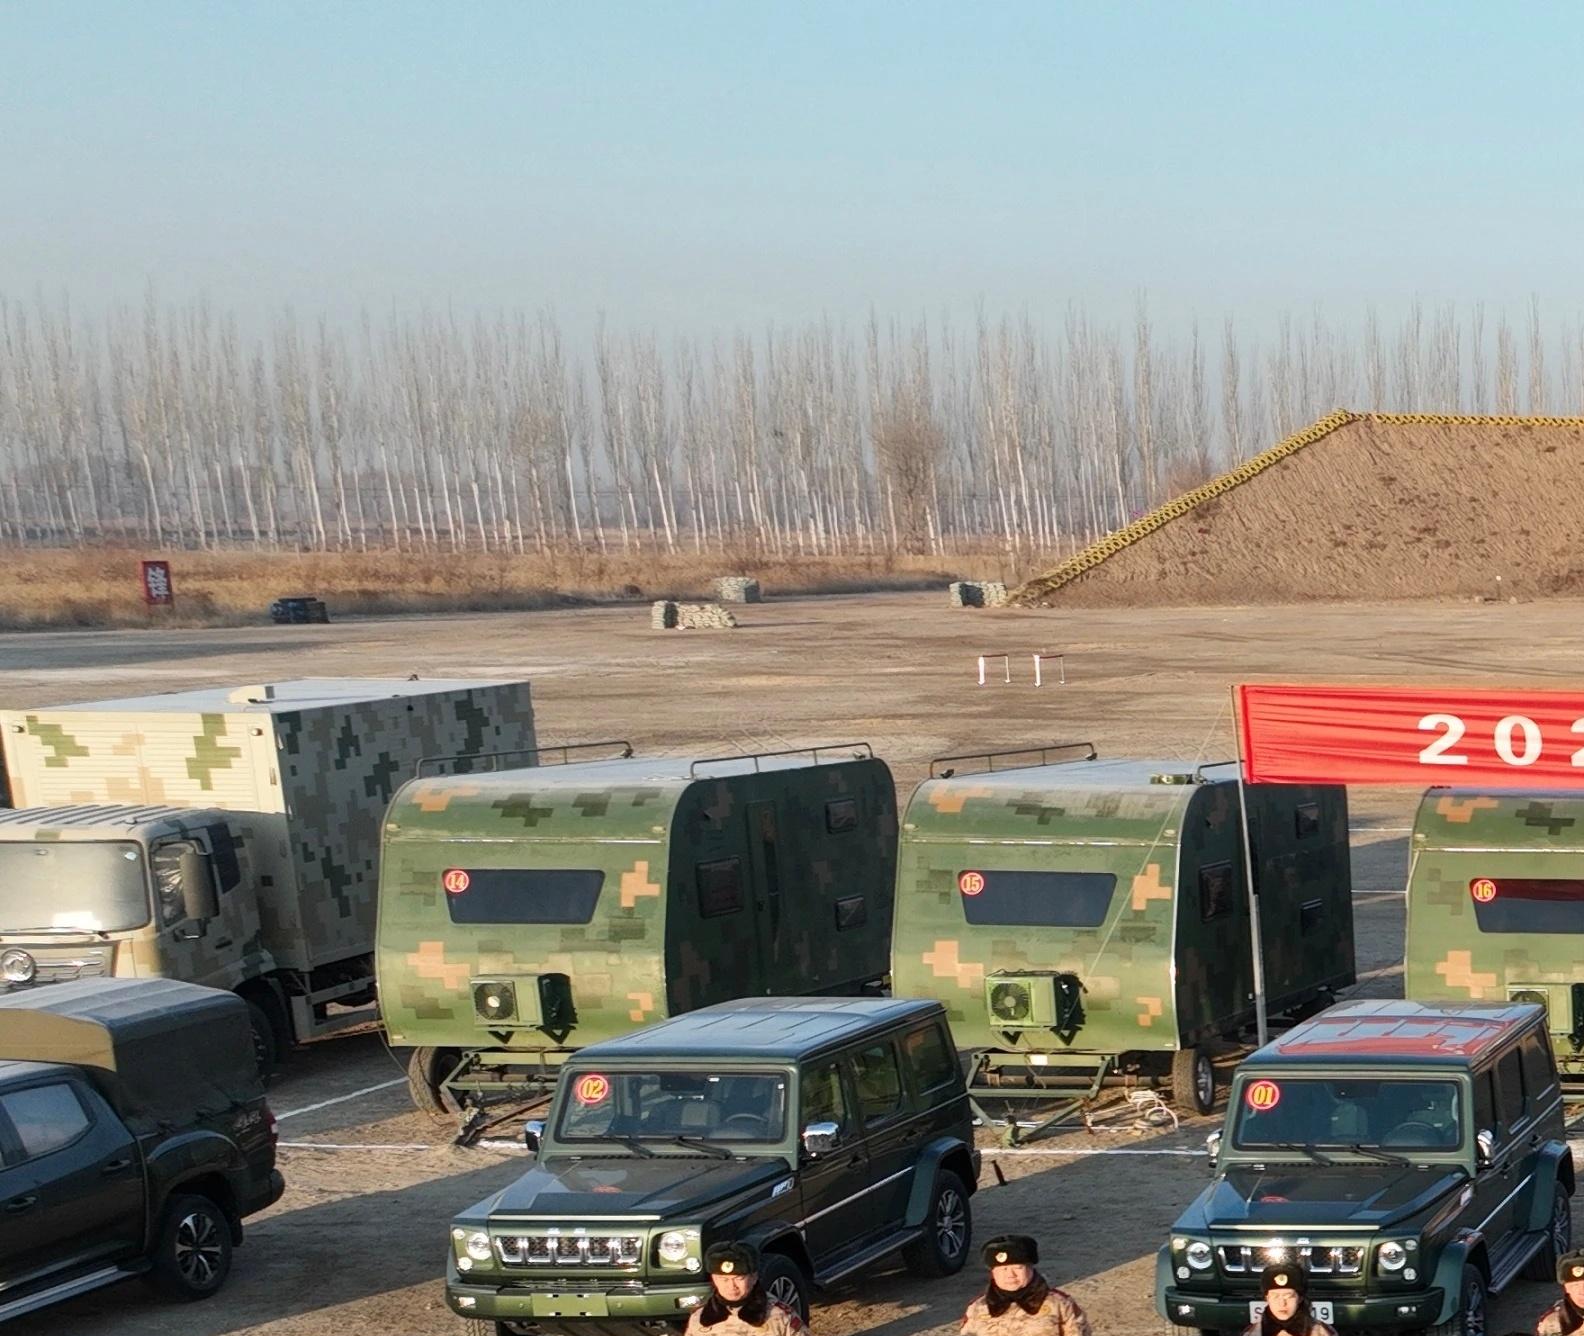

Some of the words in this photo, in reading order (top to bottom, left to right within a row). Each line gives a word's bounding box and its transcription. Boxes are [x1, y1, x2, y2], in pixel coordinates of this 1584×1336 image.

[448, 872, 466, 891] 14
[963, 874, 982, 893] 15
[1475, 882, 1493, 900] 16
[581, 1077, 606, 1101] 02
[1252, 1084, 1275, 1107] 01
